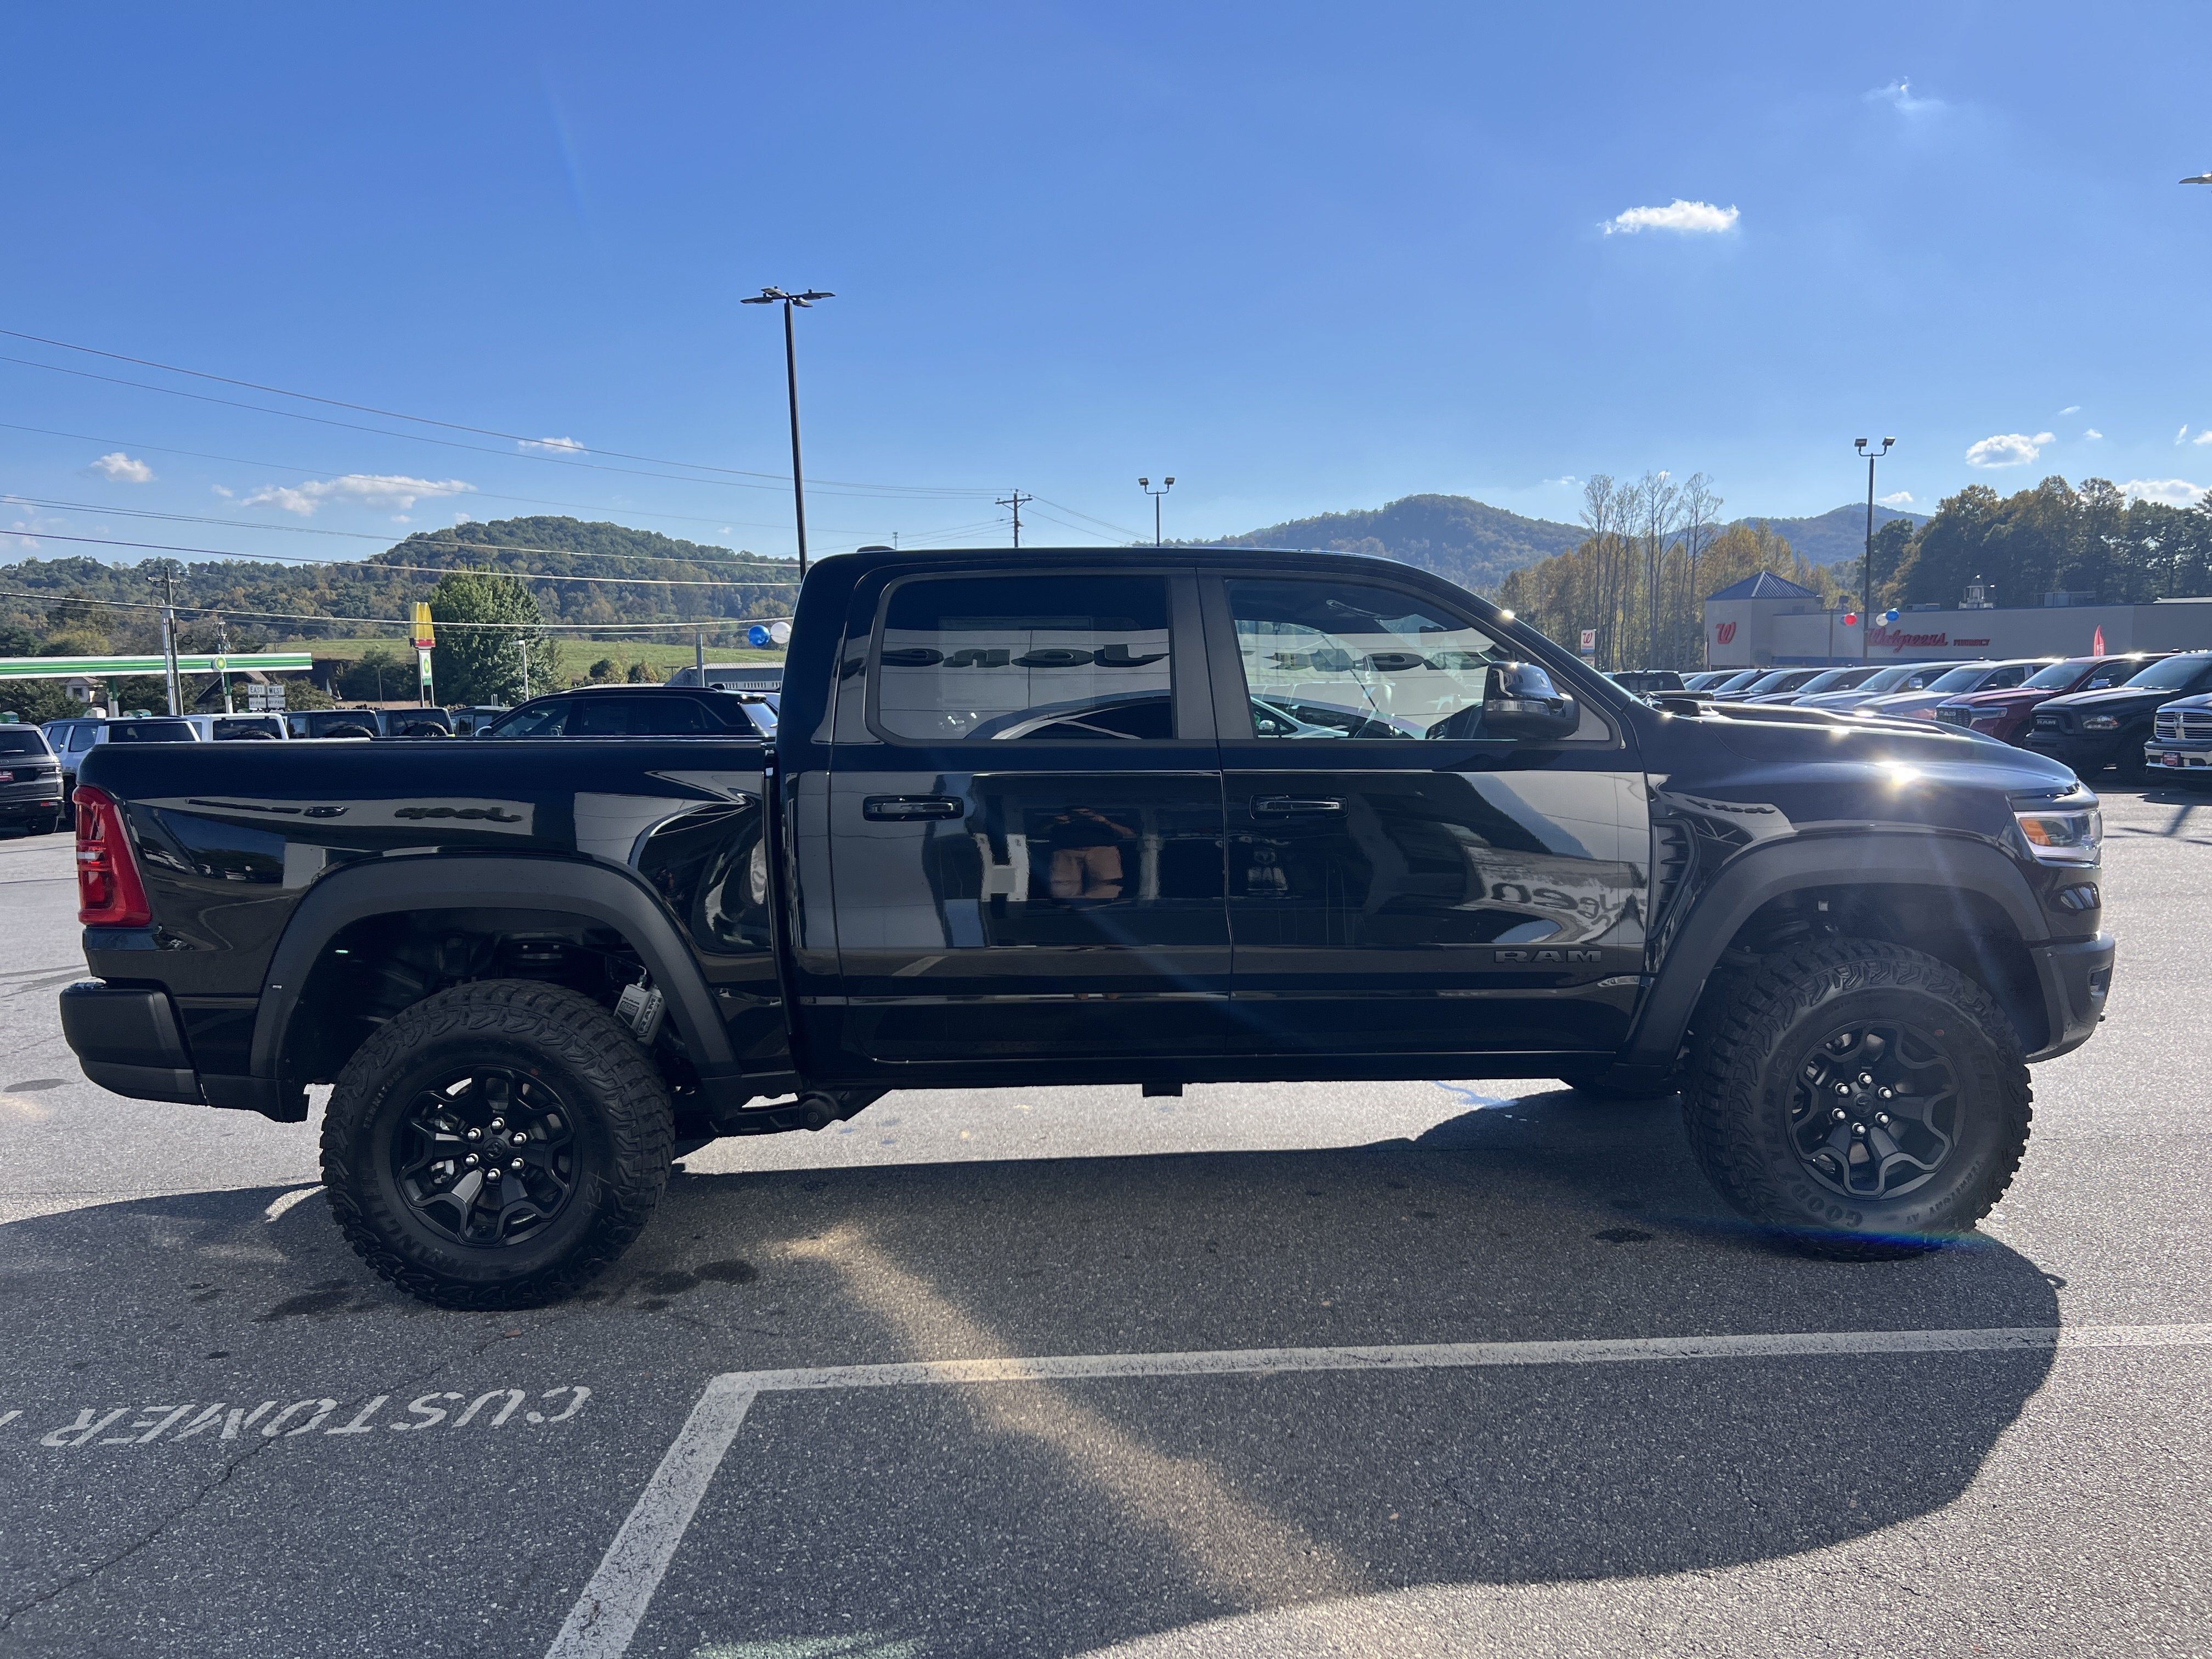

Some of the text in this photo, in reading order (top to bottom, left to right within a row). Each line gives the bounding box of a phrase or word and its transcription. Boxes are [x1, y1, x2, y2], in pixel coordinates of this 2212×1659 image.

[1869, 627, 1948, 653] Walgreens
[1494, 950, 1602, 963] RAM
[639, 998, 656, 1031] RAM
[40, 1386, 591, 1447] CUSTOMER
